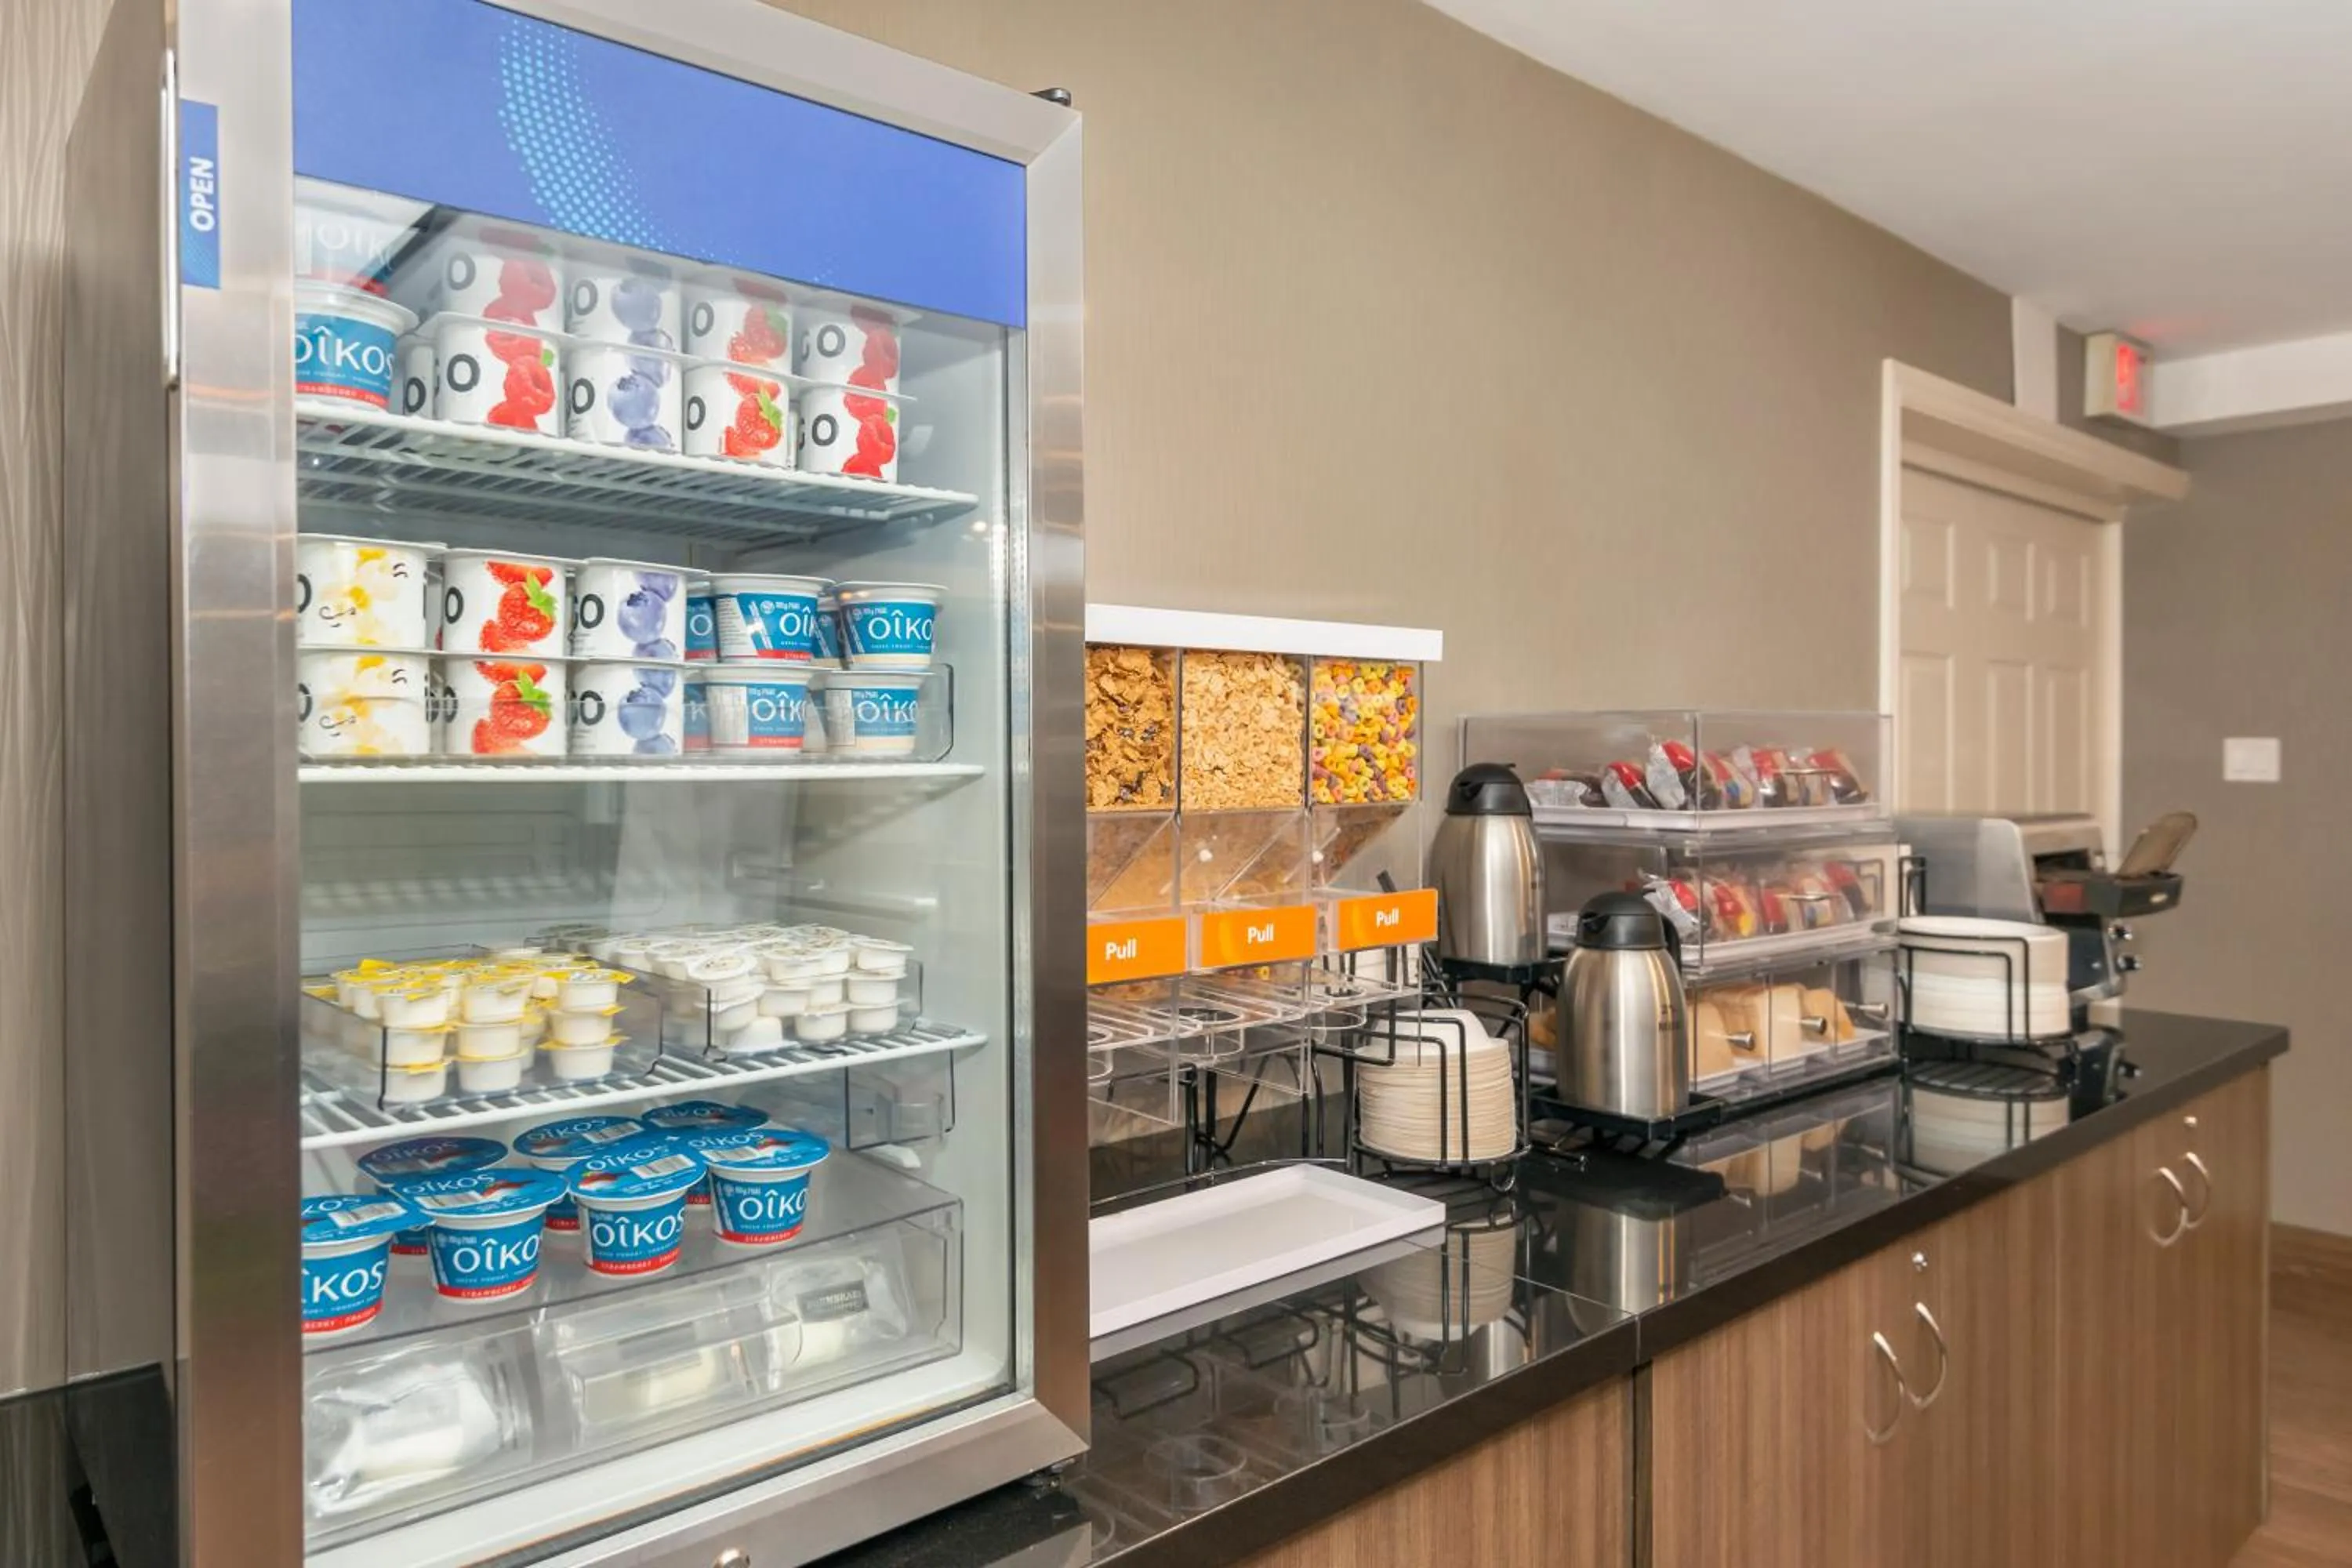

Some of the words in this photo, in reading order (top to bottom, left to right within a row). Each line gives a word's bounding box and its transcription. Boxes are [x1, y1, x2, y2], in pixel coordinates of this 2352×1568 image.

[189, 157, 215, 231] OPEN
[1376, 908, 1399, 927] Pull
[1247, 923, 1274, 944] Pull
[1105, 938, 1137, 961] Pull
